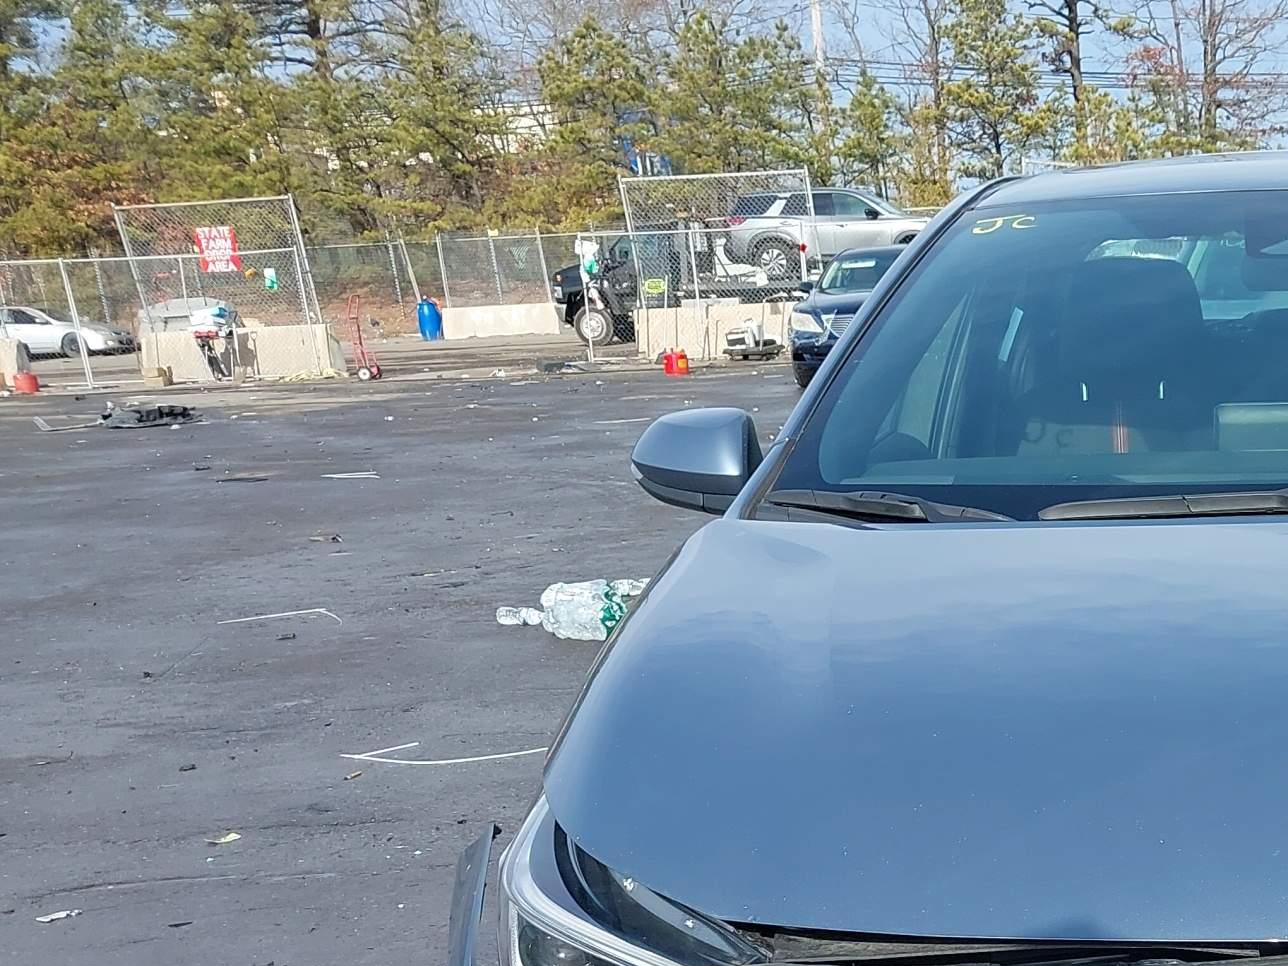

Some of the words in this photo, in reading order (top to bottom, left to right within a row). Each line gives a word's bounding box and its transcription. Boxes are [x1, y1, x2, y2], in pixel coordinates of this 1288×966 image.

[196, 226, 231, 239] STATE
[200, 238, 232, 250] FARM
[207, 260, 238, 272] AREA
